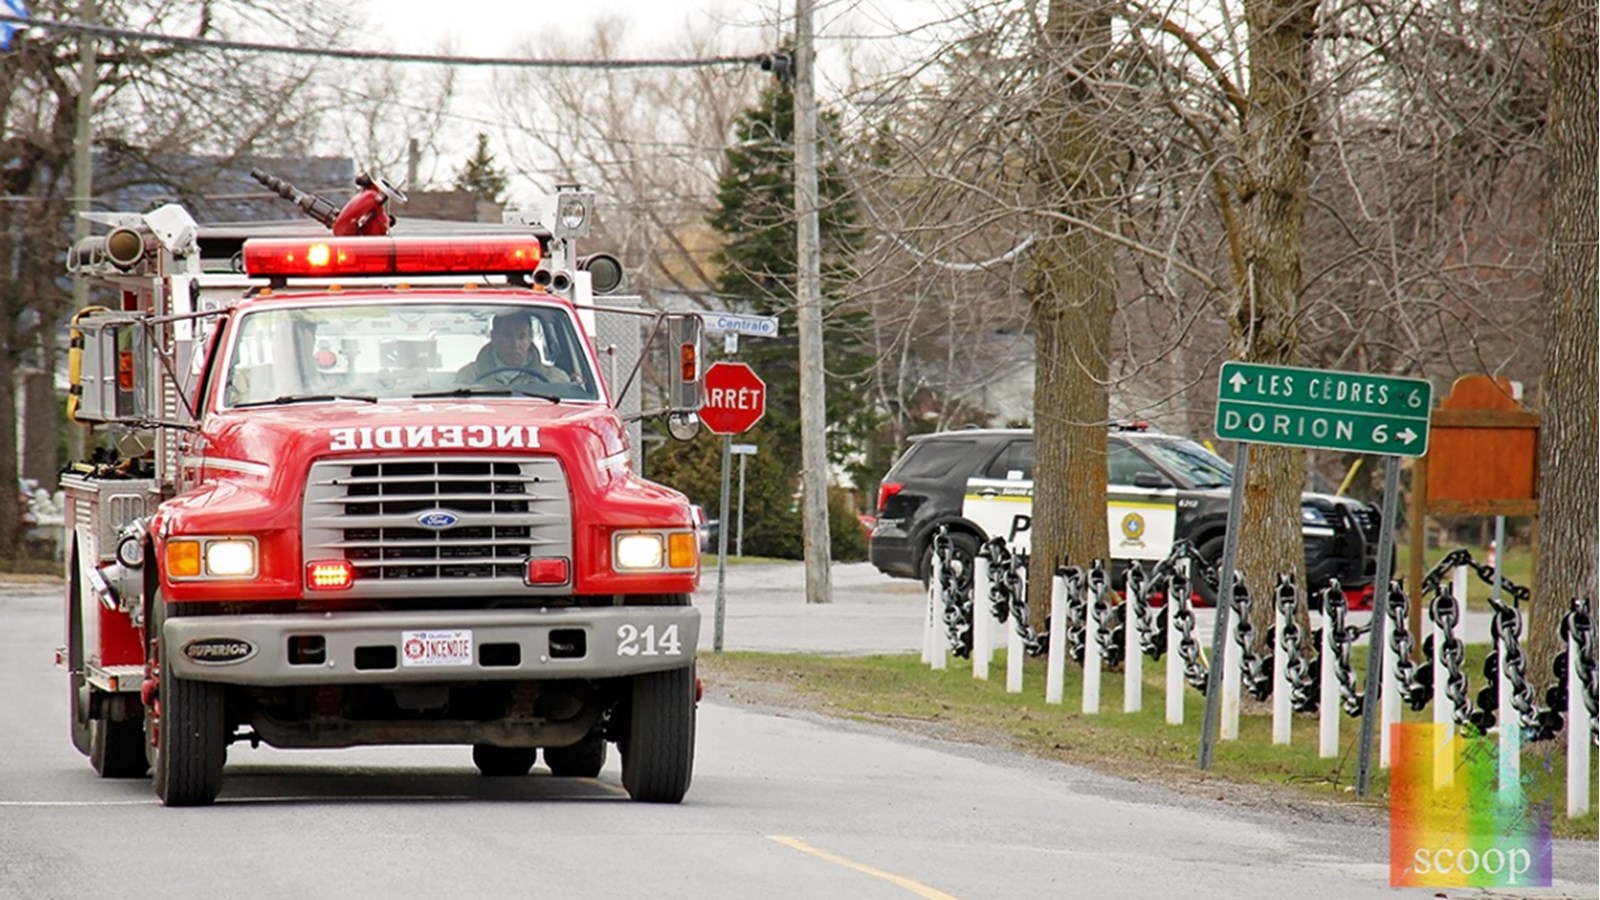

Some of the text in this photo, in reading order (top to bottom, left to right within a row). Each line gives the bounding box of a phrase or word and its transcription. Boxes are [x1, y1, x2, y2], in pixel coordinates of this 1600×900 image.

[717, 317, 769, 332] Centrale
[1257, 374, 1294, 397] LES
[1407, 389, 1422, 408] 6
[1224, 410, 1389, 444] DORION 6
[426, 515, 449, 526] Ford
[426, 640, 469, 658] INCENDIE
[617, 623, 682, 657] 214
[188, 643, 249, 657] SUPERIOR
